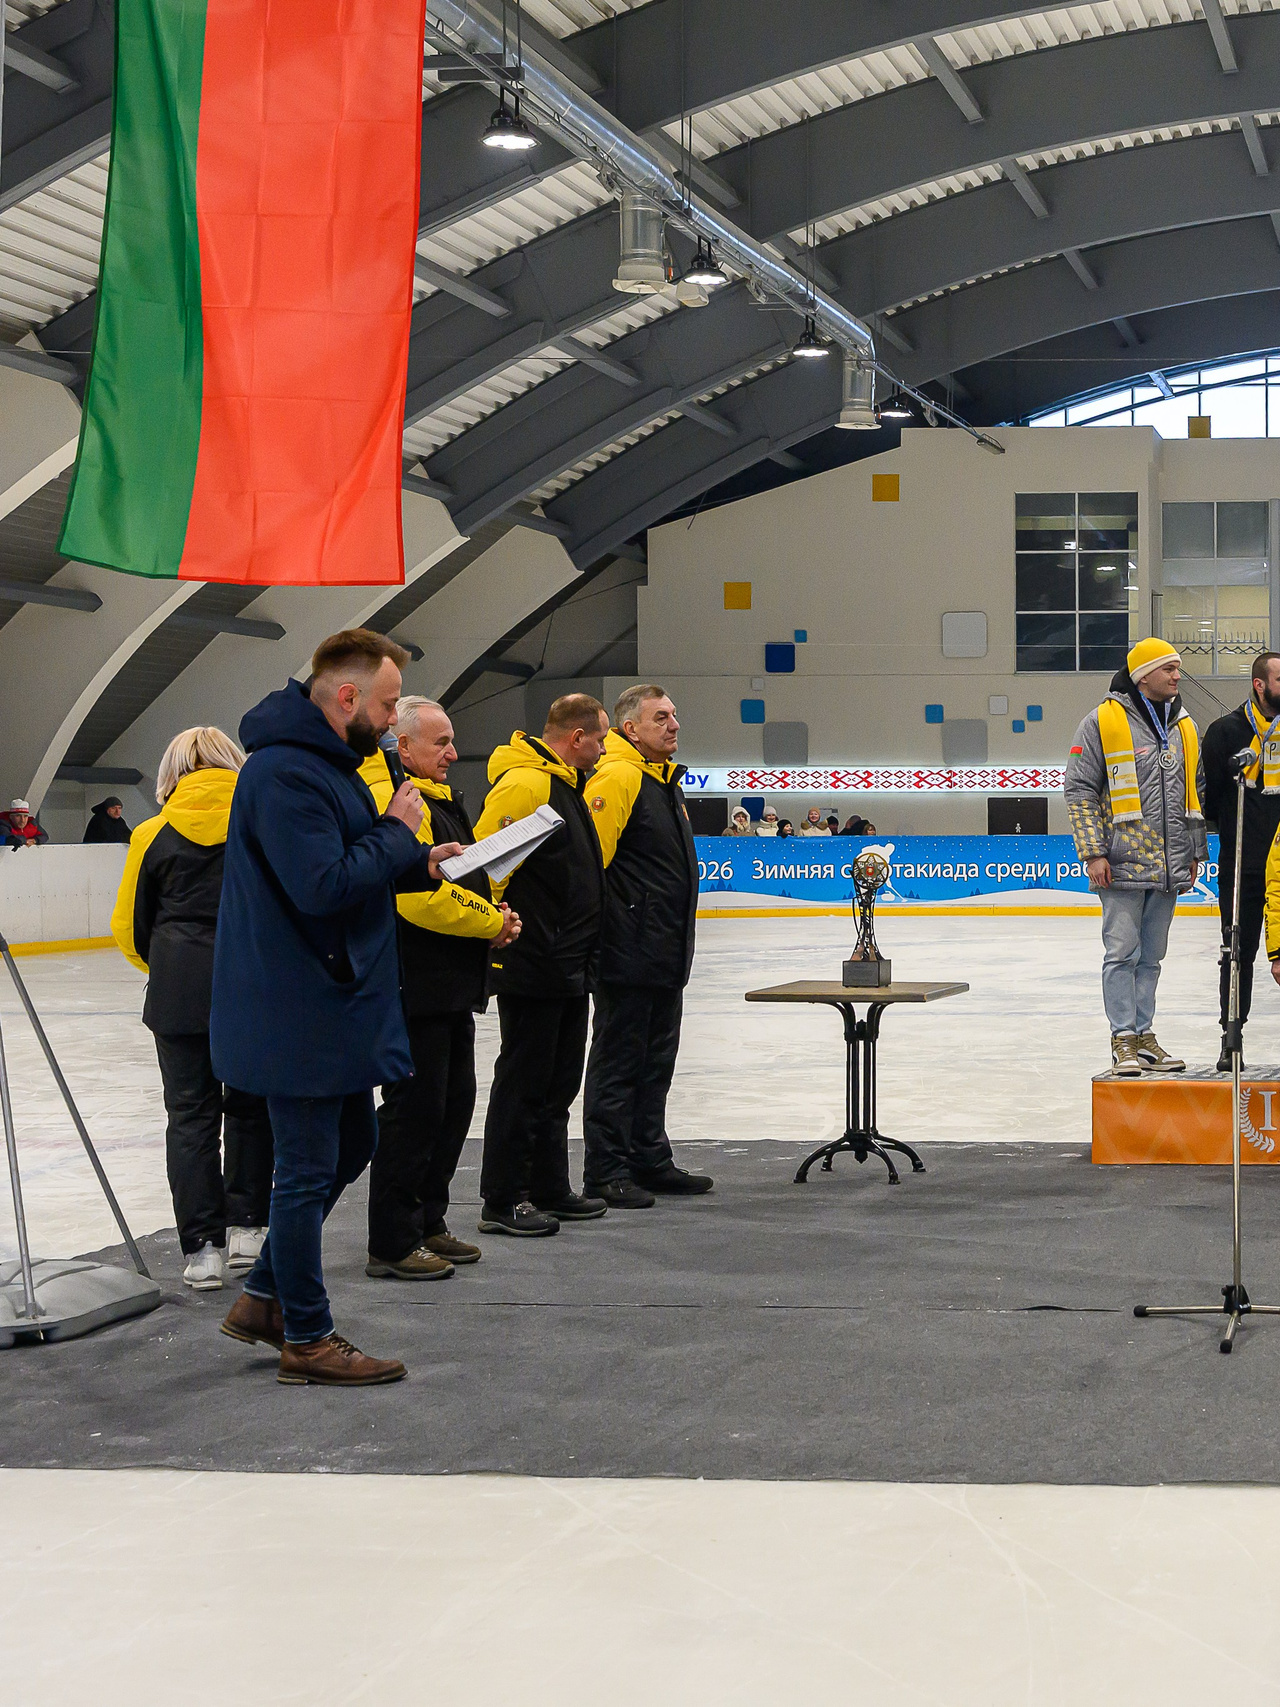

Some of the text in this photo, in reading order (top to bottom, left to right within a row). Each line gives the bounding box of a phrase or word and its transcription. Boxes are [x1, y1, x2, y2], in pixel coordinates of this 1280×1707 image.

[698, 860, 734, 880] 026
[752, 860, 834, 880] Зимняя
[840, 862, 978, 883] стакиада
[985, 862, 1050, 883] среди
